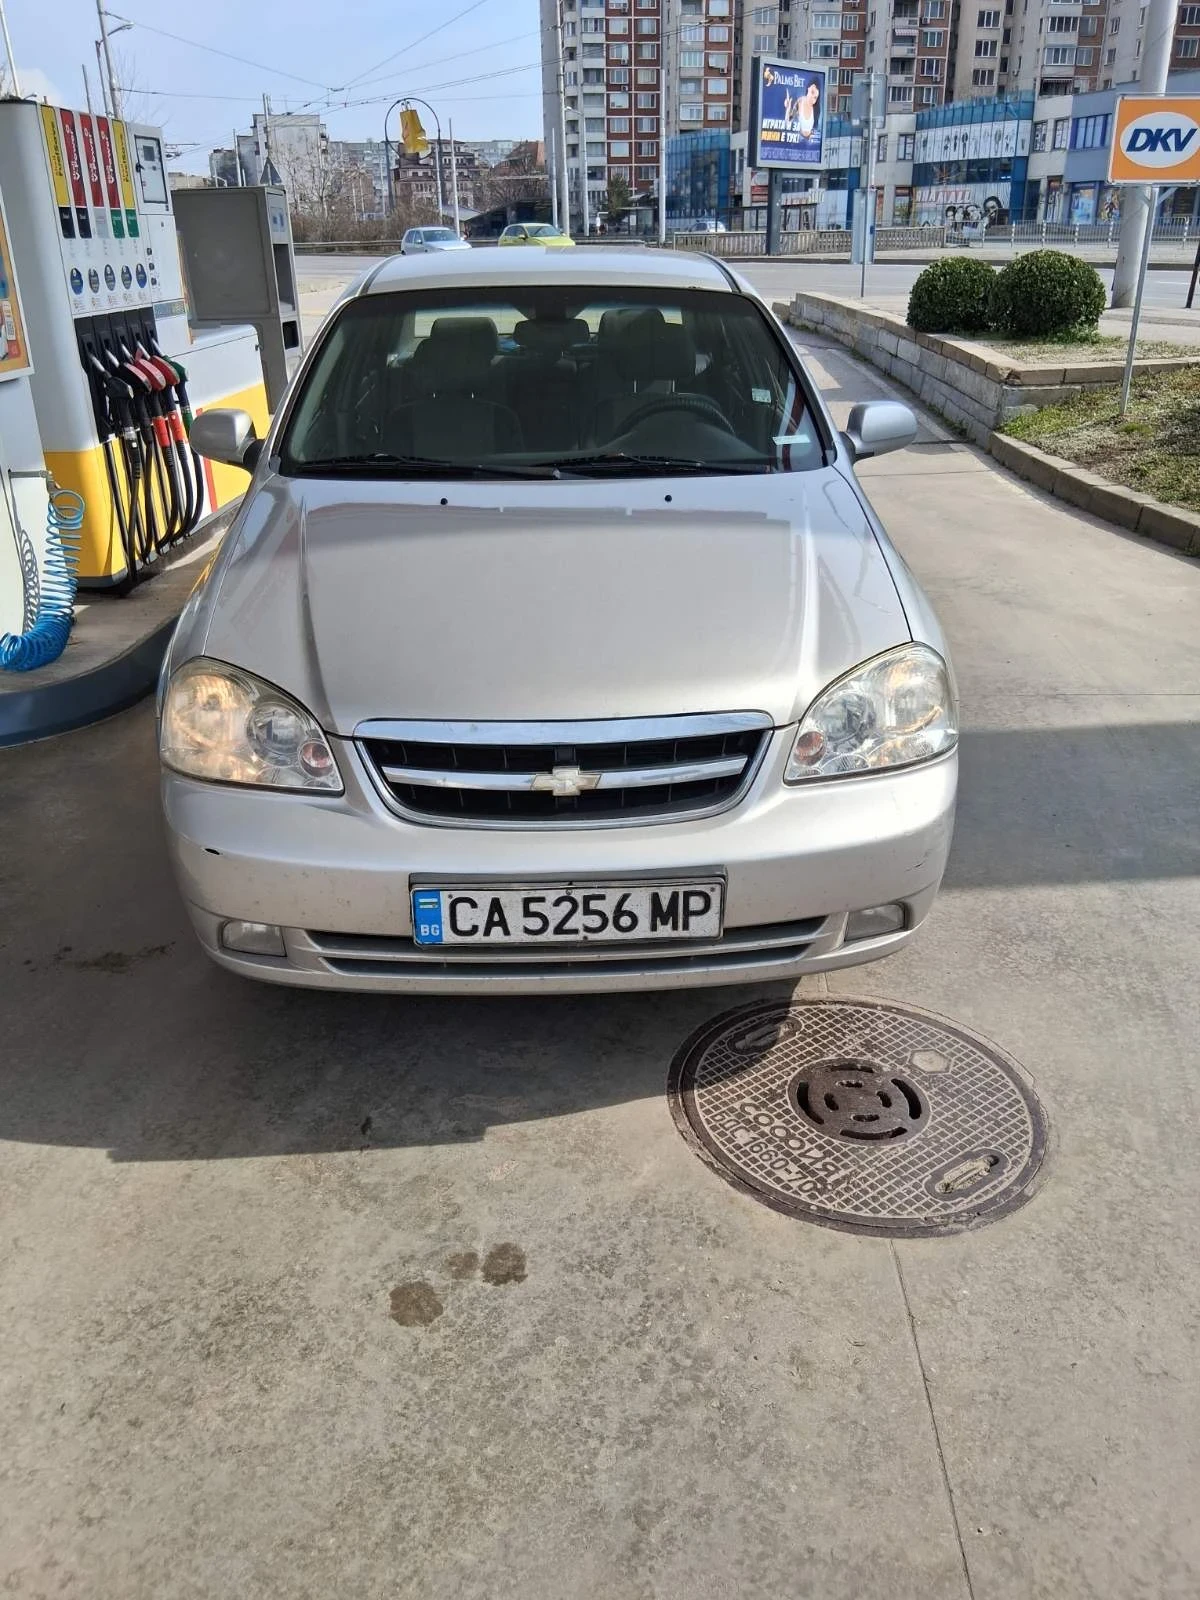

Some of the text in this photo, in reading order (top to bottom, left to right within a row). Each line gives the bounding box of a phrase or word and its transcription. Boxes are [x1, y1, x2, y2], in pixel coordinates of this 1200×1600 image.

[1126, 128, 1198, 152] DKV
[420, 890, 712, 938] BG CA 5256 MP
[710, 1111, 818, 1193] БДС 1660-70
[740, 1102, 842, 1181] СОФИЯ
